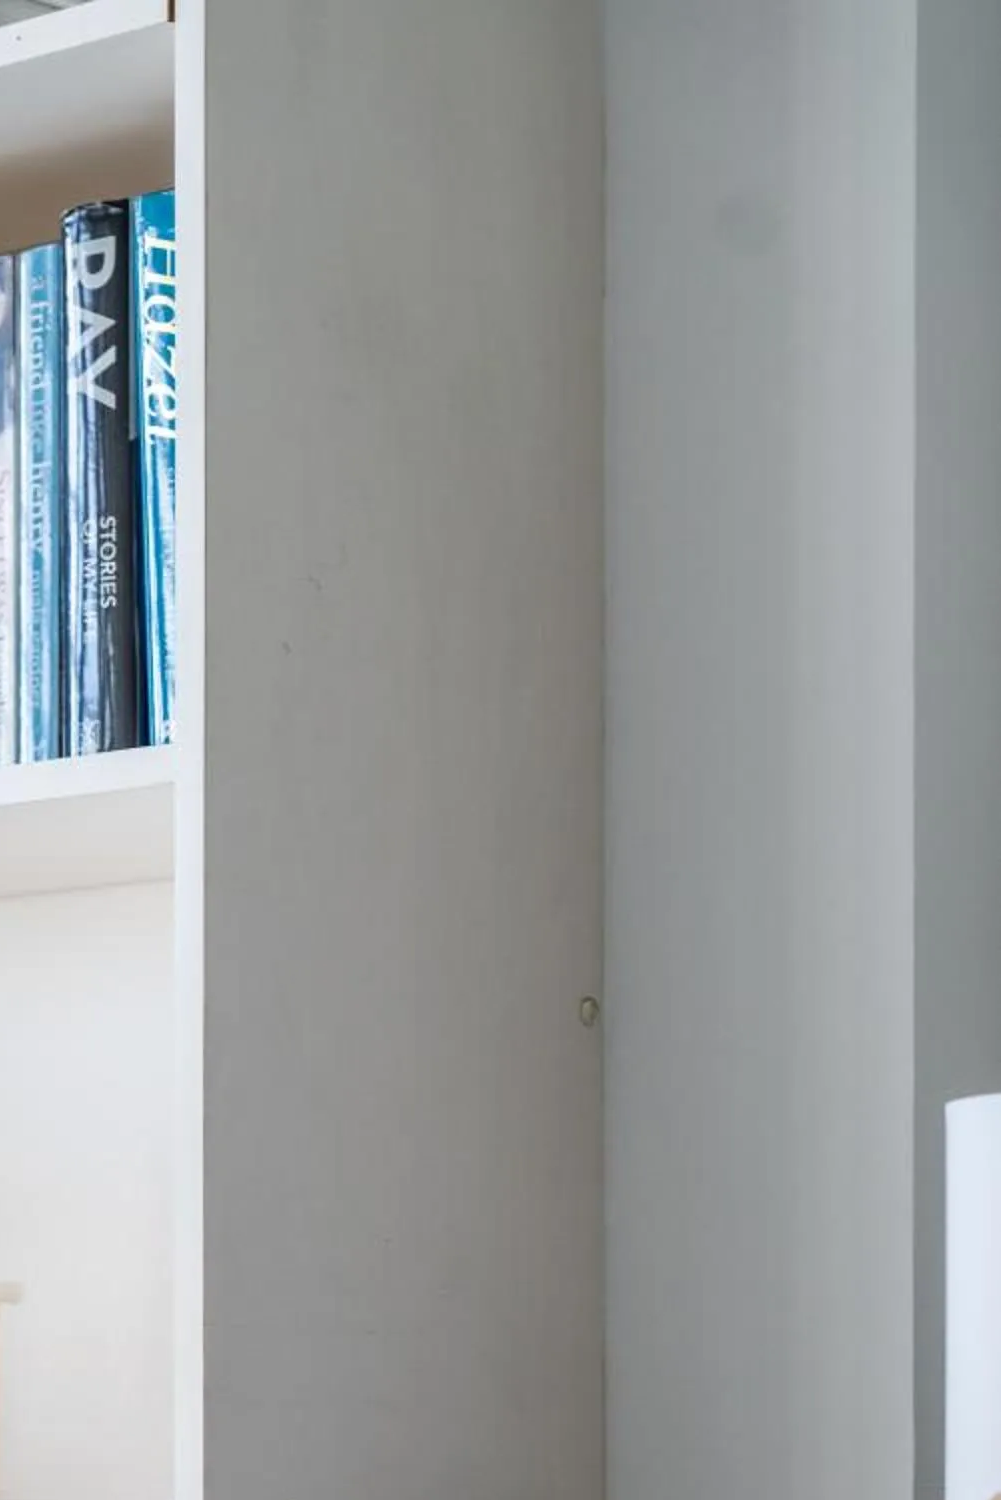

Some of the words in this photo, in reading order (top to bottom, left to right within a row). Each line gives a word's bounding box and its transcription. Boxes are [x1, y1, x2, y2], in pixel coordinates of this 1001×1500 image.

[29, 299, 54, 390] friend
[29, 460, 52, 552] henry
[82, 556, 98, 591] MY
[99, 515, 117, 609] STORIES
